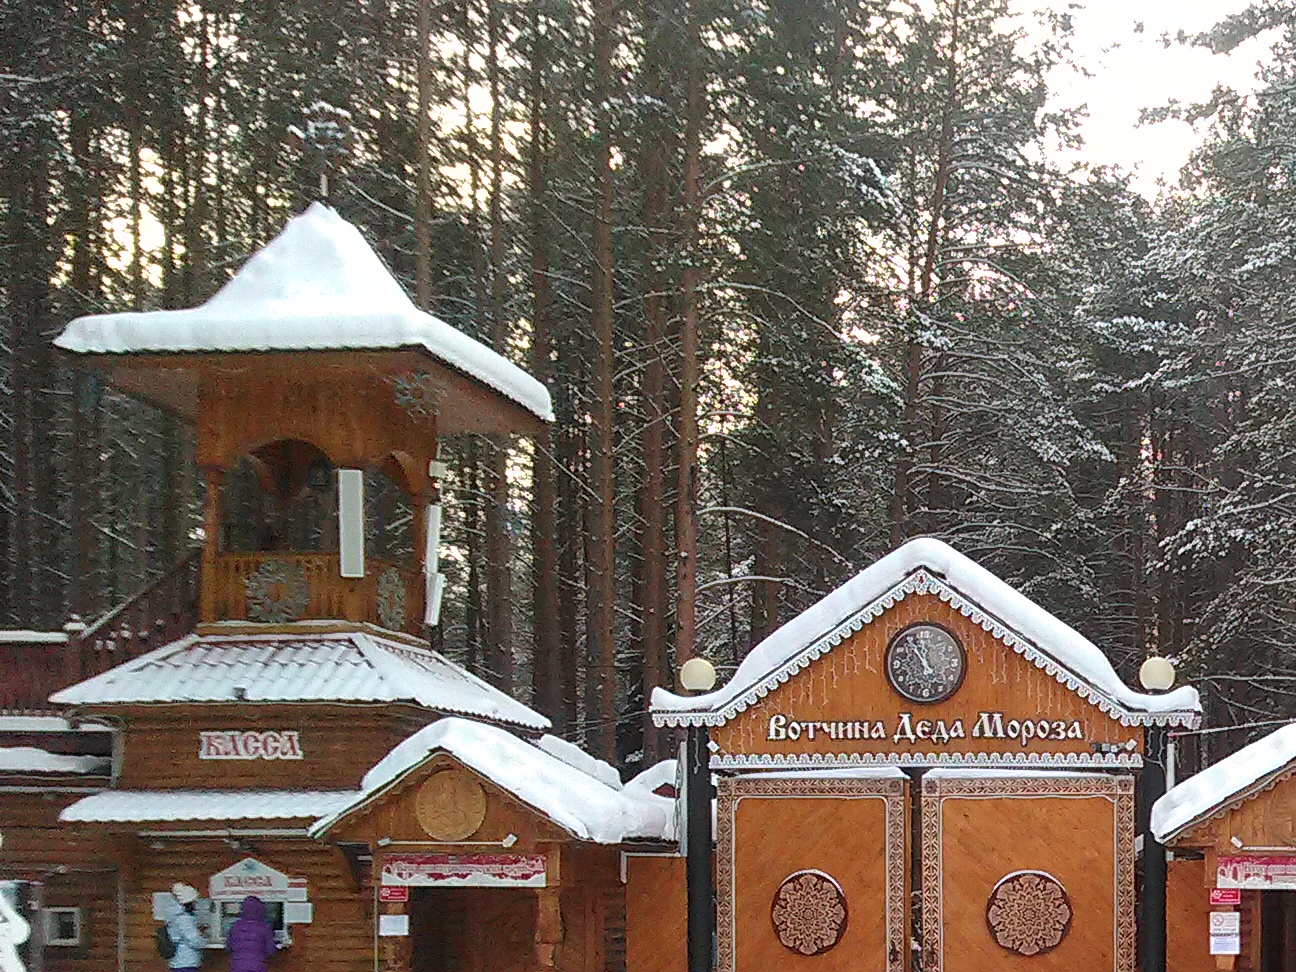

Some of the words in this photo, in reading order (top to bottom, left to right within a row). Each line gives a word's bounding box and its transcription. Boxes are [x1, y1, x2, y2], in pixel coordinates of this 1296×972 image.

[766, 714, 887, 741] Вотчина
[893, 713, 966, 745] Деда
[972, 712, 1083, 747] Мороза
[202, 733, 301, 758] КАССА
